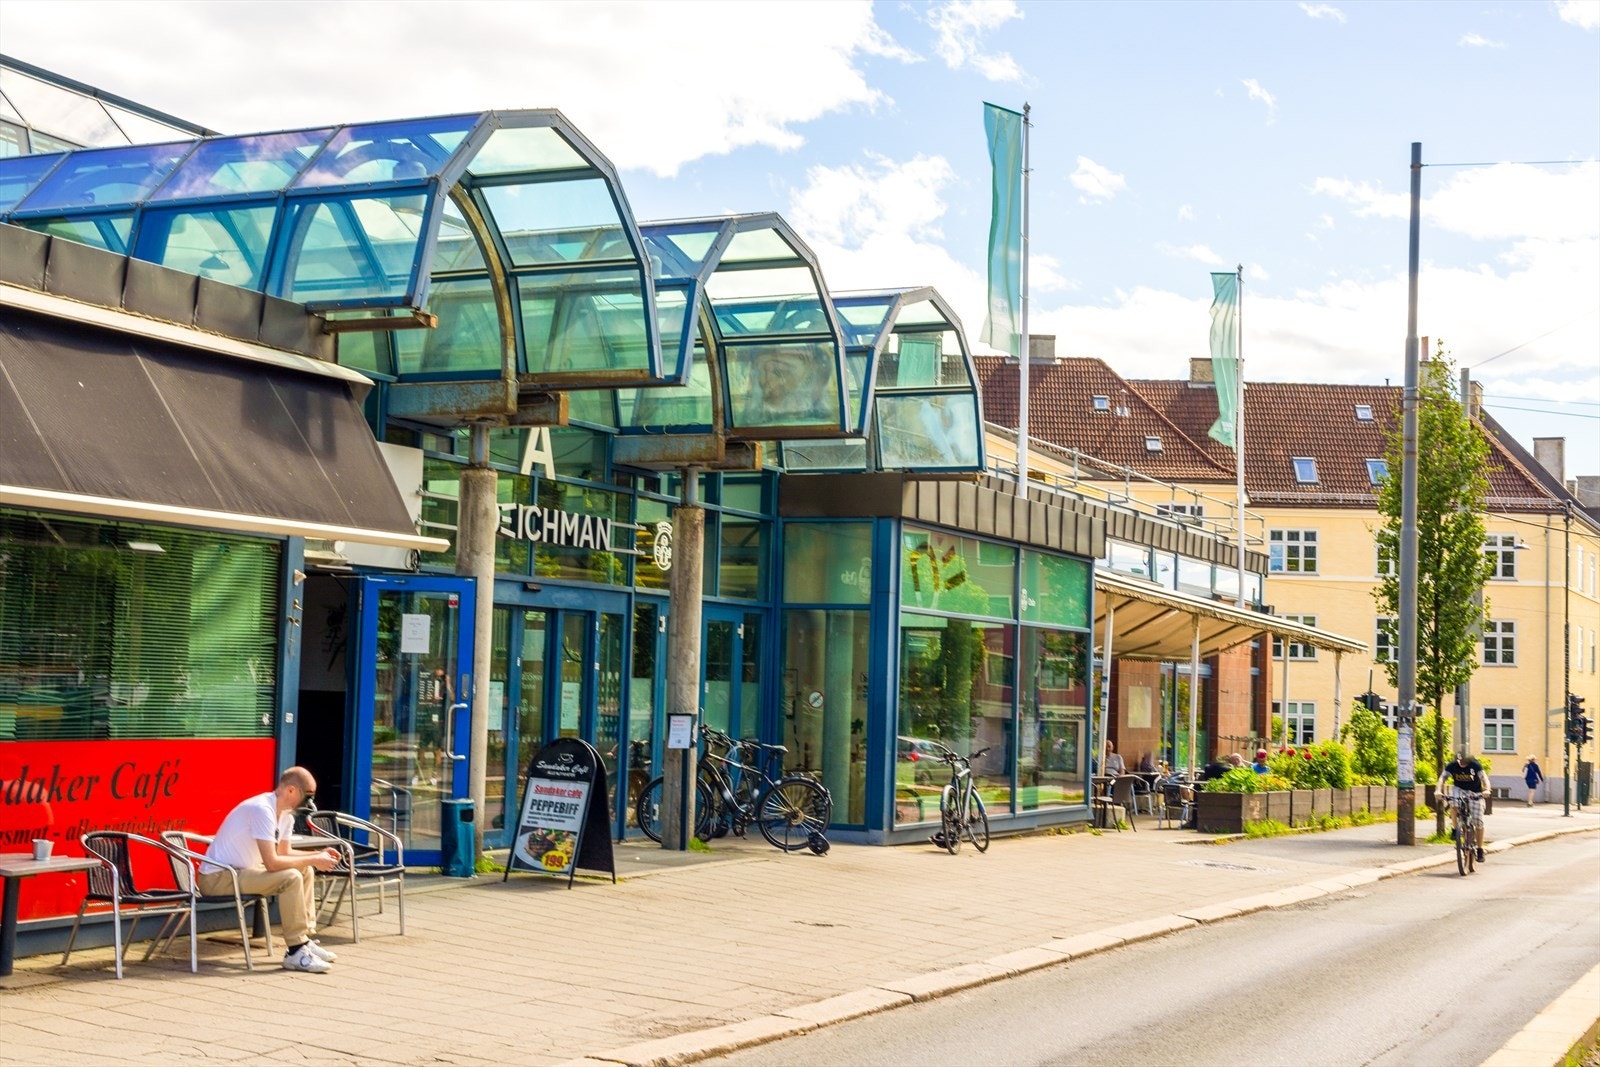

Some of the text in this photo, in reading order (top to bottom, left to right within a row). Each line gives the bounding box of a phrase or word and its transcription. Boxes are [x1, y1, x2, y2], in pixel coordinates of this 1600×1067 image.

[520, 427, 556, 480] A
[0, 759, 181, 808] daker Café
[534, 785, 567, 795] Sandaker
[530, 799, 580, 815] PEPPEBIFF
